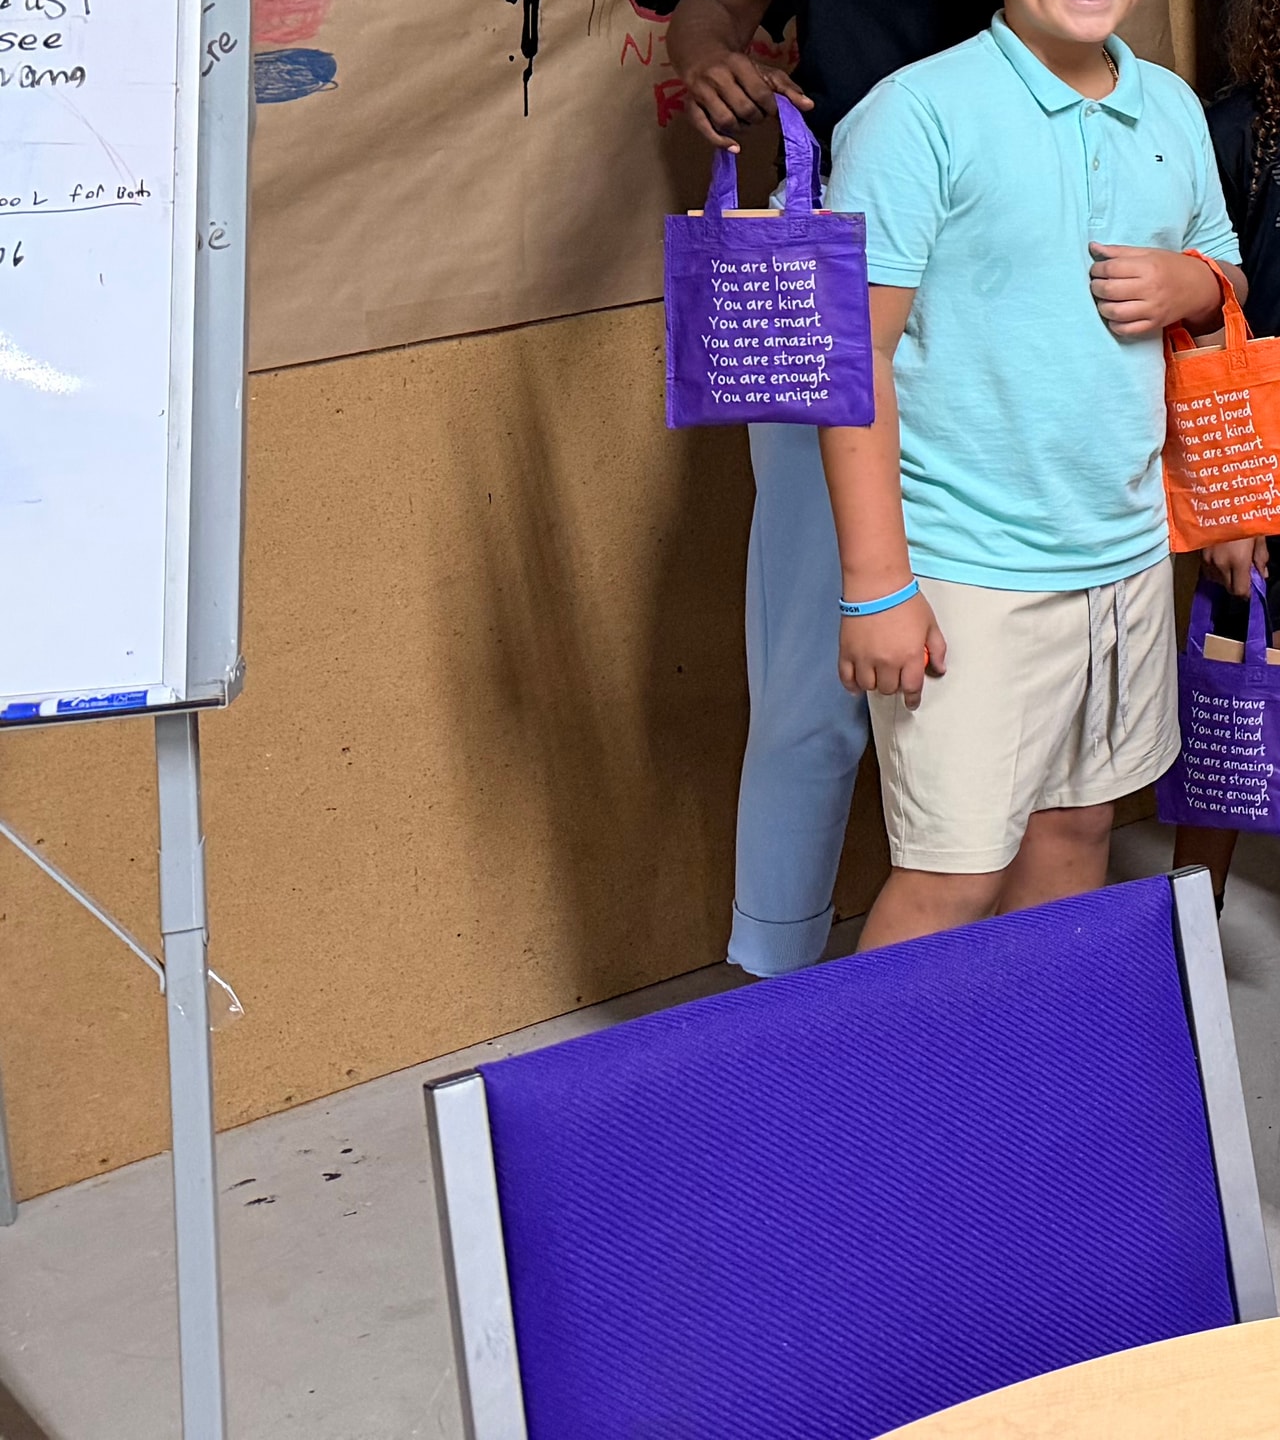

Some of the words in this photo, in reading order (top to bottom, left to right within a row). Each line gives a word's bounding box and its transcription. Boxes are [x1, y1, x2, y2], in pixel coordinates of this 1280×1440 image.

[712, 259, 737, 273] You
[741, 262, 767, 273] are
[772, 256, 816, 271] brave
[712, 279, 739, 292] You
[743, 281, 770, 291] are
[775, 274, 815, 291] loved
[701, 335, 729, 348] You
[734, 337, 759, 347] are
[764, 333, 833, 351] amazing
[707, 372, 735, 385] You
[740, 374, 765, 384] are
[770, 369, 830, 388] enough
[1175, 416, 1194, 429] You
[1196, 414, 1217, 425] are
[1220, 403, 1252, 422] loved
[1179, 434, 1200, 446] You
[1202, 430, 1222, 442] are
[1226, 421, 1255, 439] kind
[1197, 514, 1217, 527] You
[1219, 513, 1238, 524] are
[1192, 690, 1211, 704] You
[1212, 697, 1229, 708] are
[1232, 696, 1265, 709] brave
[1187, 737, 1208, 750] You
[1210, 743, 1227, 753] are
[1231, 744, 1265, 756] smart
[1186, 768, 1205, 780] You
[1208, 773, 1226, 784] are
[1229, 775, 1267, 790] strong
